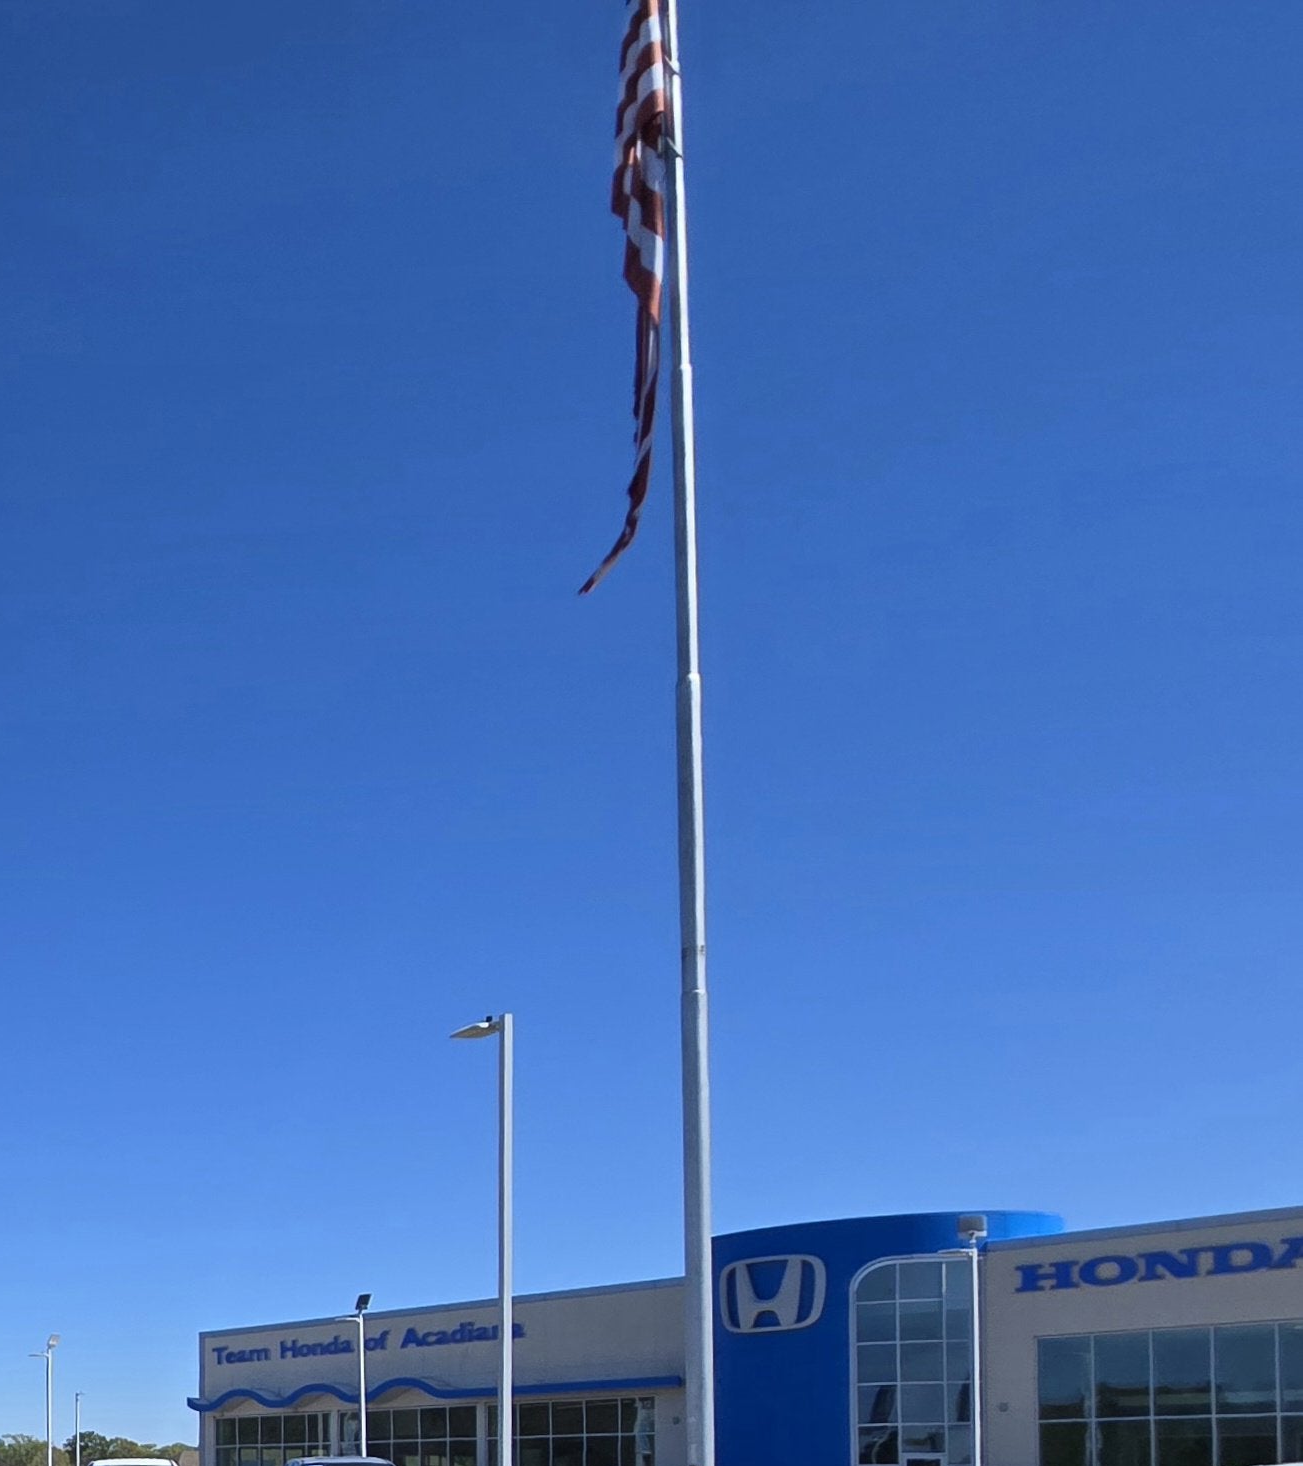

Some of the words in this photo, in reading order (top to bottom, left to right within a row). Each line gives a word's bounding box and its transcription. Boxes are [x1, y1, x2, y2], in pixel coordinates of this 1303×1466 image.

[213, 1345, 271, 1365] Team
[280, 1335, 355, 1359] Honda
[364, 1330, 390, 1351] of
